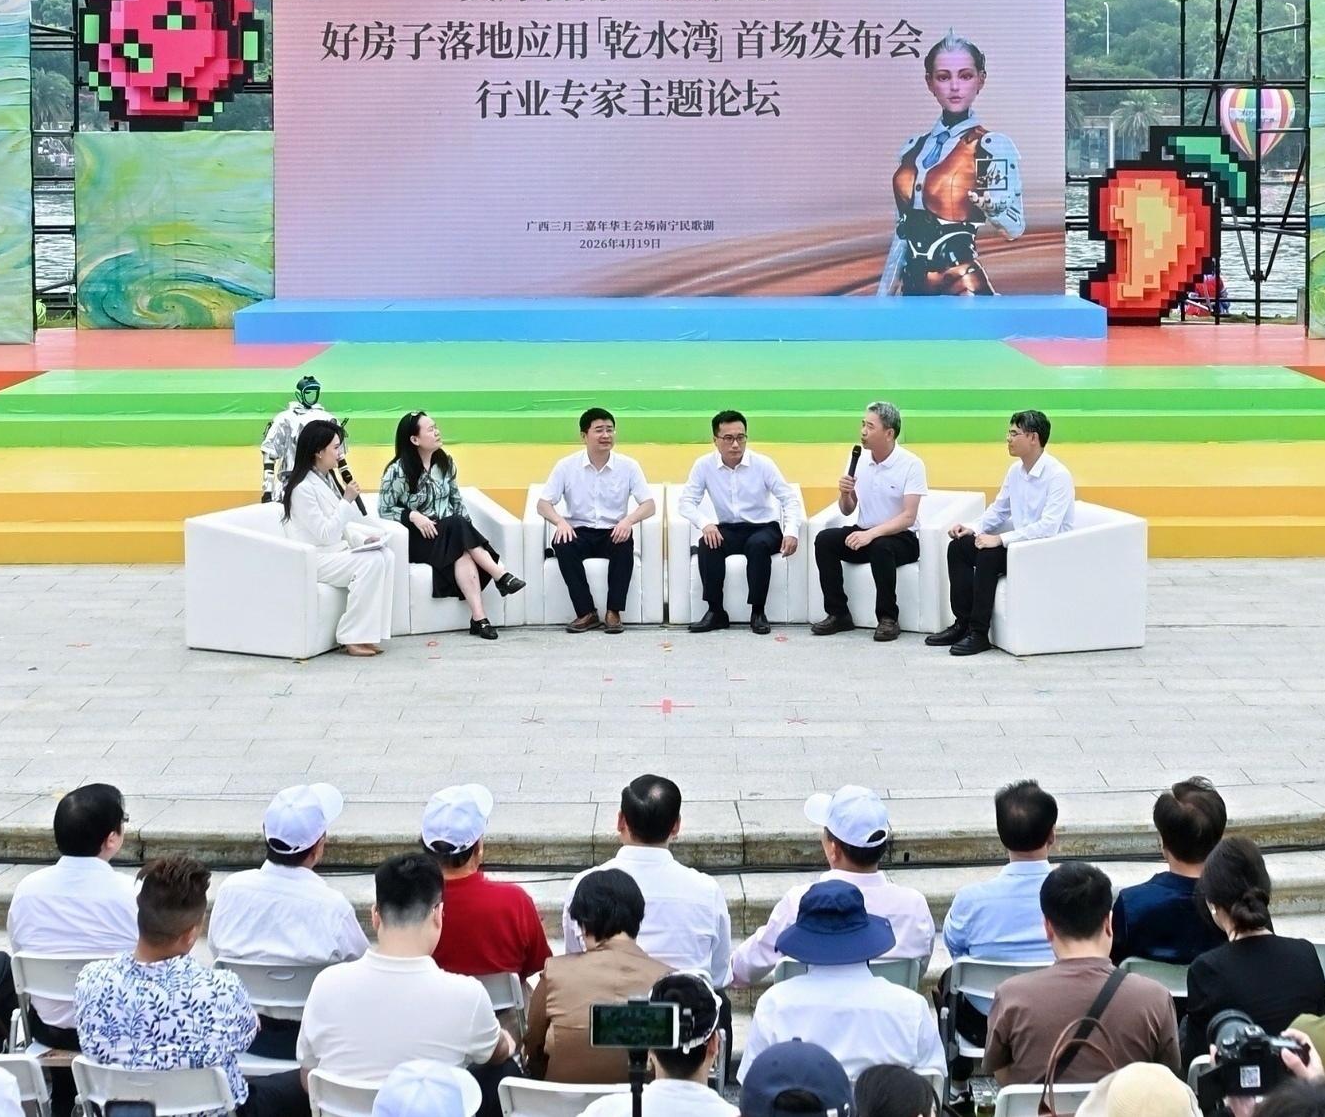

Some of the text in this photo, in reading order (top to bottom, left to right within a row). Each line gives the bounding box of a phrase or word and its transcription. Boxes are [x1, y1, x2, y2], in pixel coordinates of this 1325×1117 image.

[475, 78, 781, 119] 行业专家主题论坛
[526, 220, 715, 232] 广西三月三嘉年华主会场南宁民歌湖
[579, 238, 661, 249] 2026年4月19日
